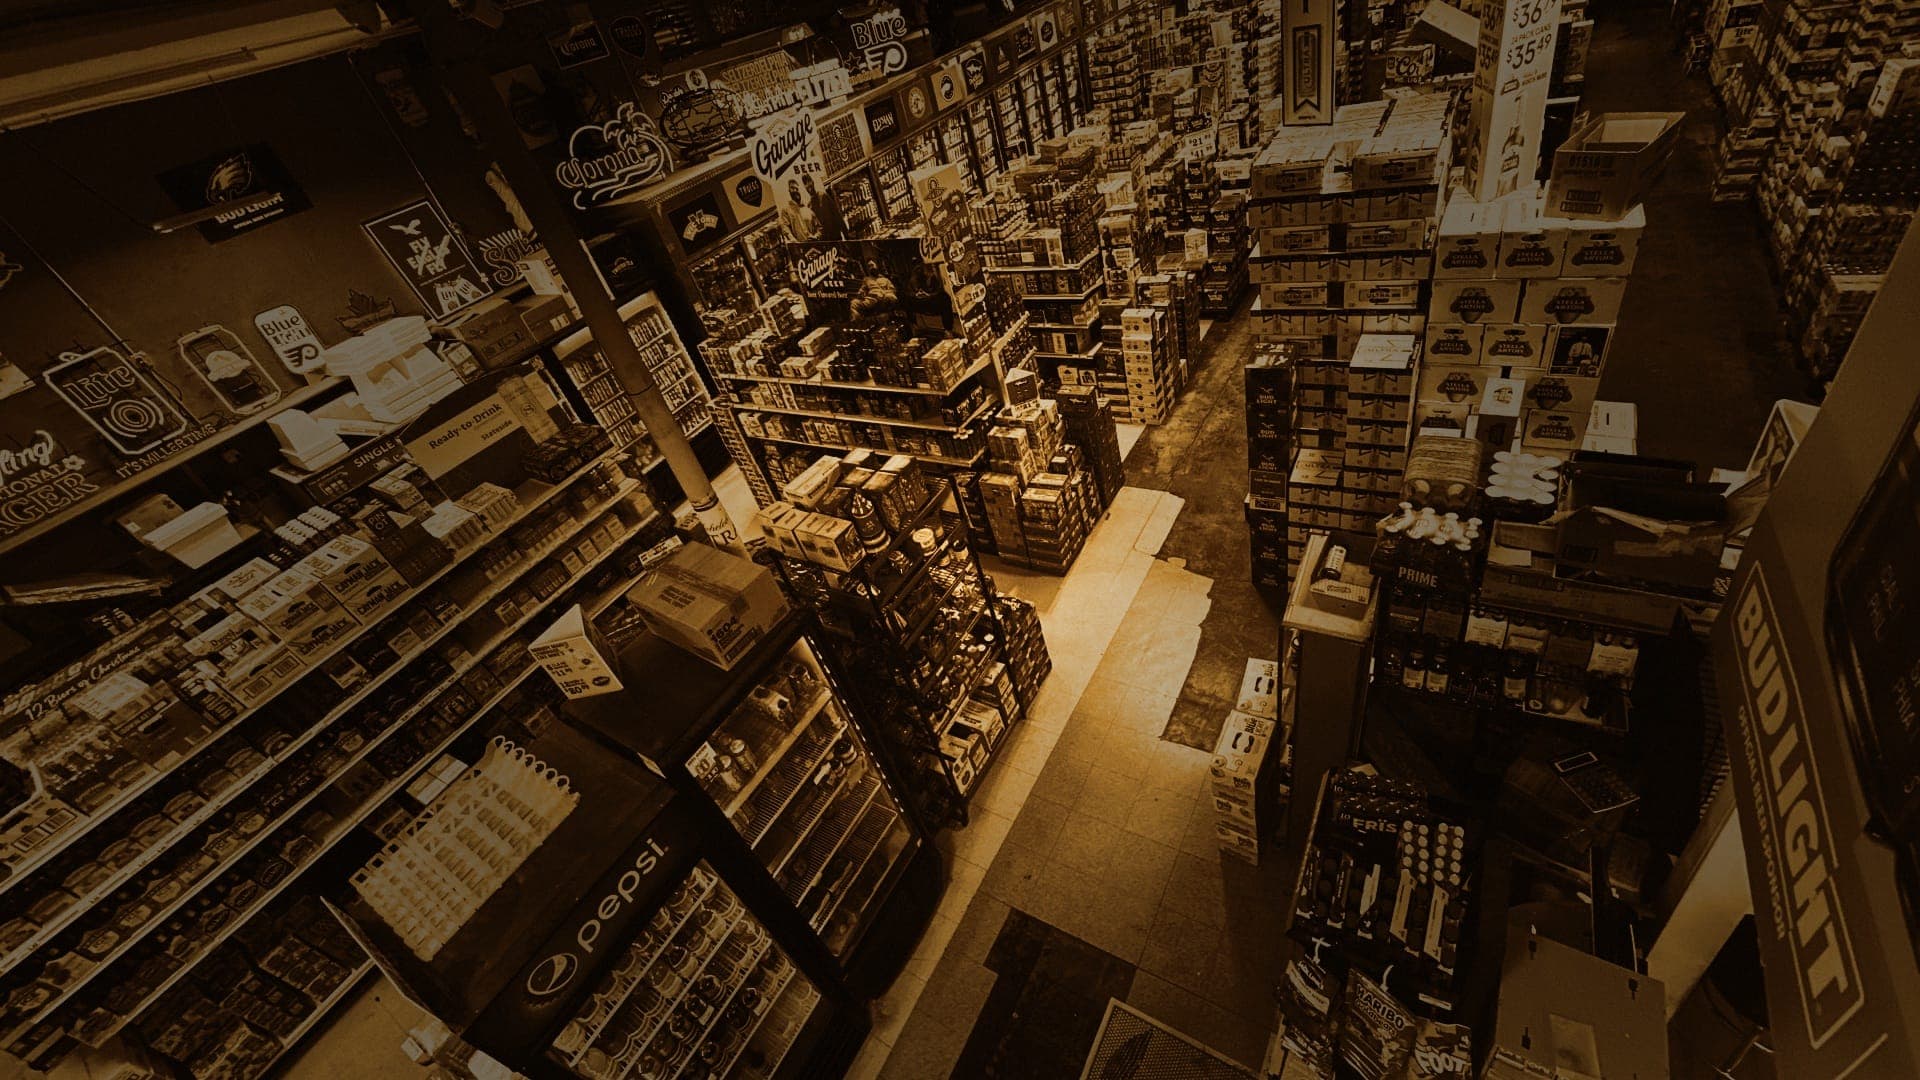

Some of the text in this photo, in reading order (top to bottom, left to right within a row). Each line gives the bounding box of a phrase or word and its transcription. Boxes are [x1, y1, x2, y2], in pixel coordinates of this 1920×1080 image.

[851, 14, 908, 50] Blue
[756, 112, 814, 178] Garage
[556, 146, 644, 188] Corona
[793, 162, 822, 175] BEER
[798, 246, 839, 288] Garage
[260, 315, 301, 336] Blue
[116, 423, 217, 479] IT'S MILLER TIME
[335, 558, 382, 593] CAYMAN JACK
[1397, 565, 1440, 589] PRIME
[357, 580, 401, 616] CAYMAN JACK
[25, 702, 44, 722] 12
[90, 645, 142, 681] Christmas
[1736, 596, 1848, 1000] BUD LIGHT
[577, 837, 665, 953] pepsi
[1356, 983, 1405, 1031] HARIBO
